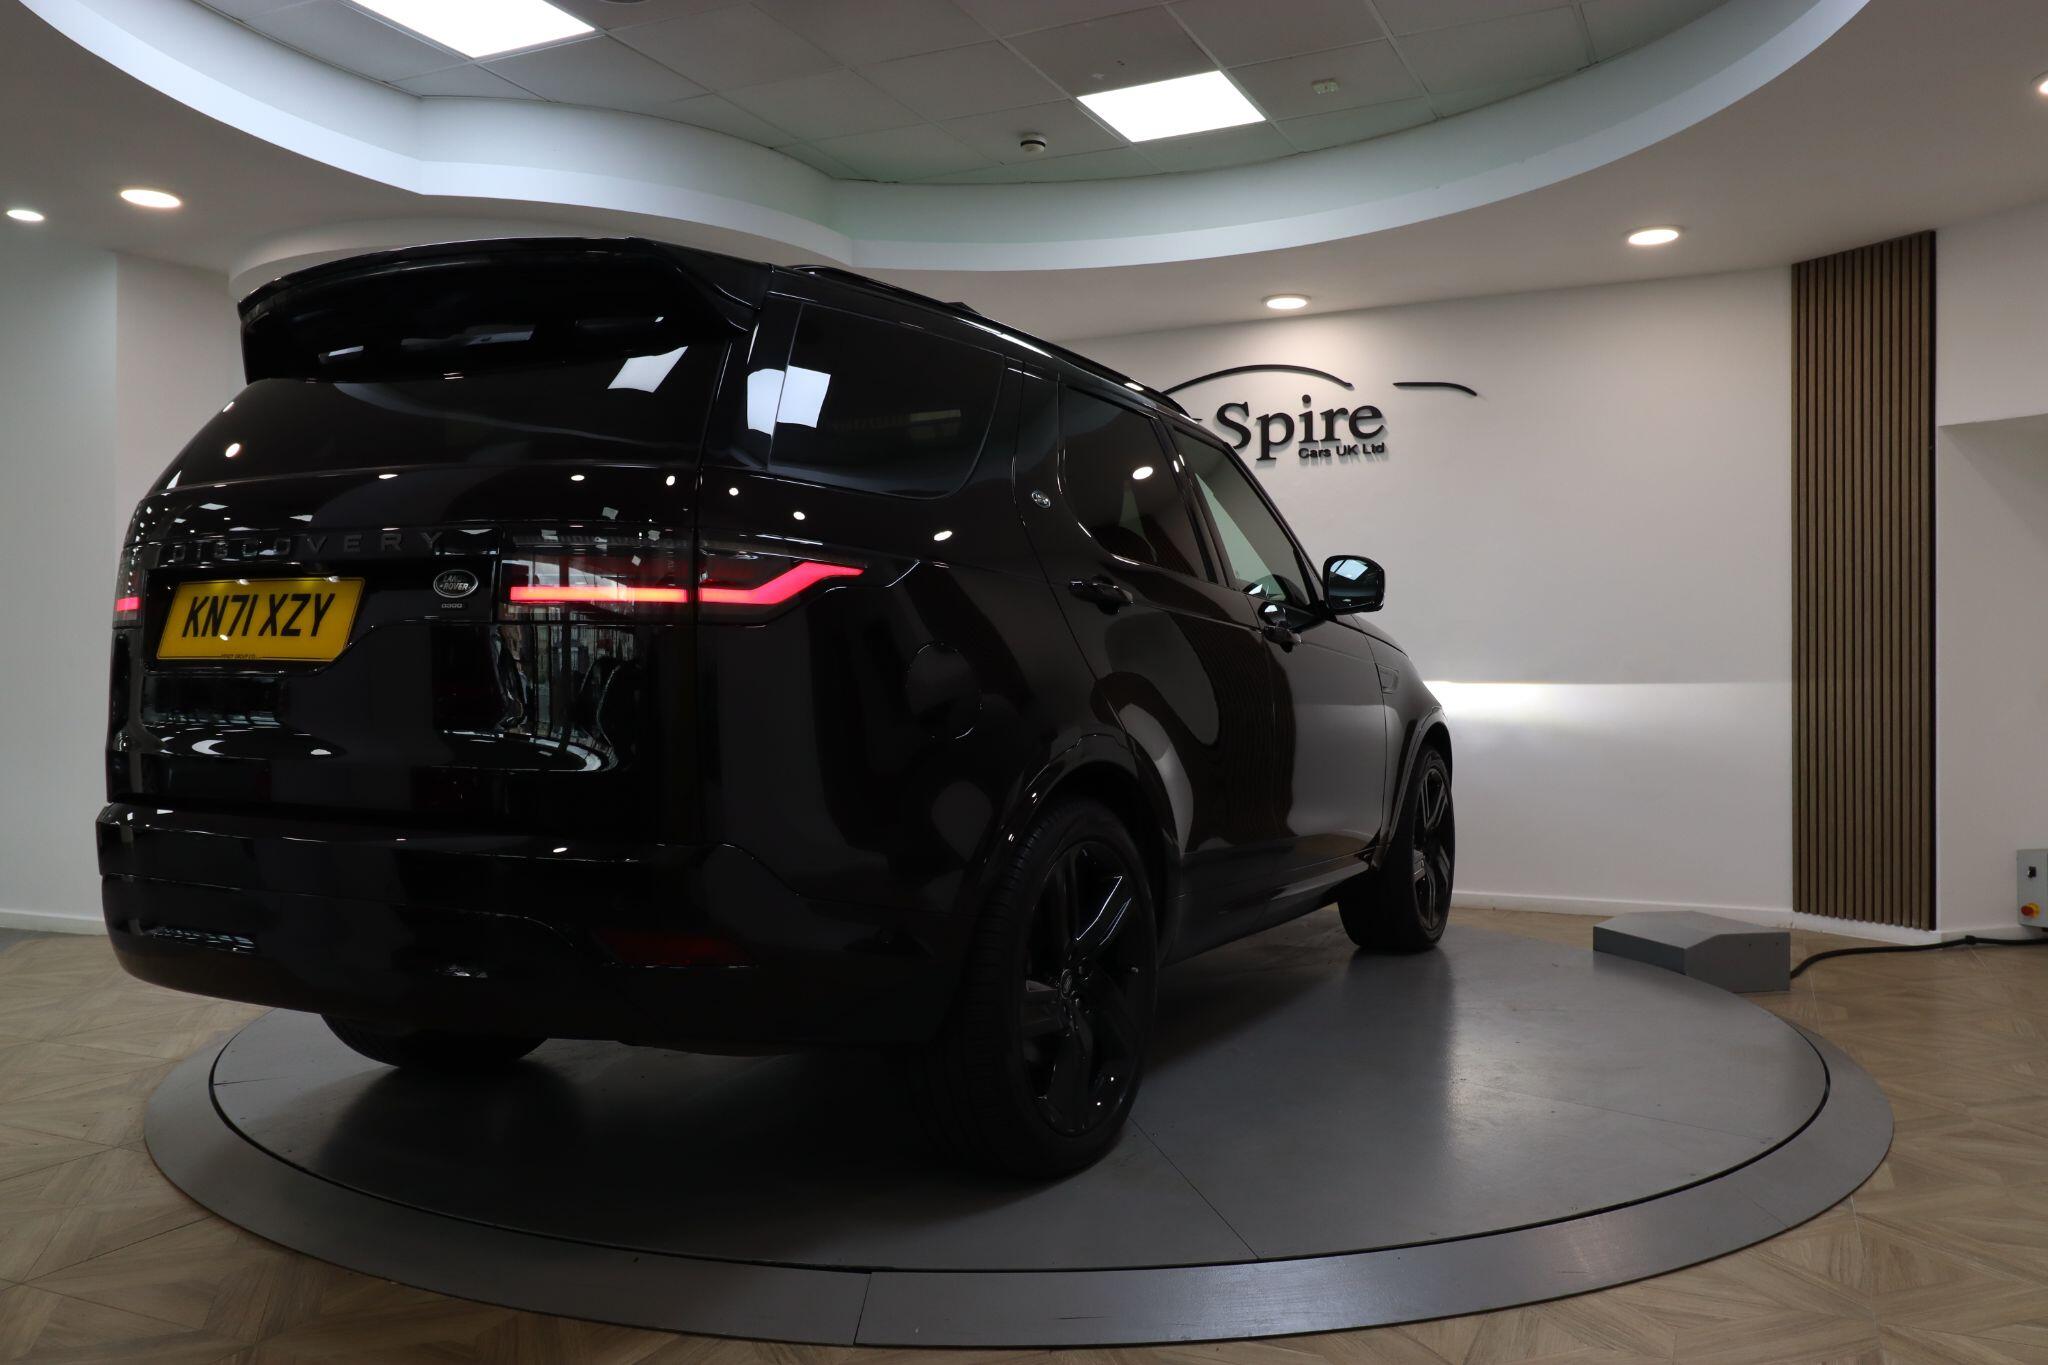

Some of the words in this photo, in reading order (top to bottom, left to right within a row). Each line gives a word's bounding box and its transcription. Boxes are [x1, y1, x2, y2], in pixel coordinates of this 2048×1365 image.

[1216, 394, 1385, 461] Spire
[1298, 447, 1331, 459] Cars
[1336, 444, 1358, 456] UK
[1362, 443, 1385, 455] Ltd
[172, 531, 443, 562] DISCOVERY
[182, 594, 259, 638] KN71
[258, 593, 336, 637] XZY
